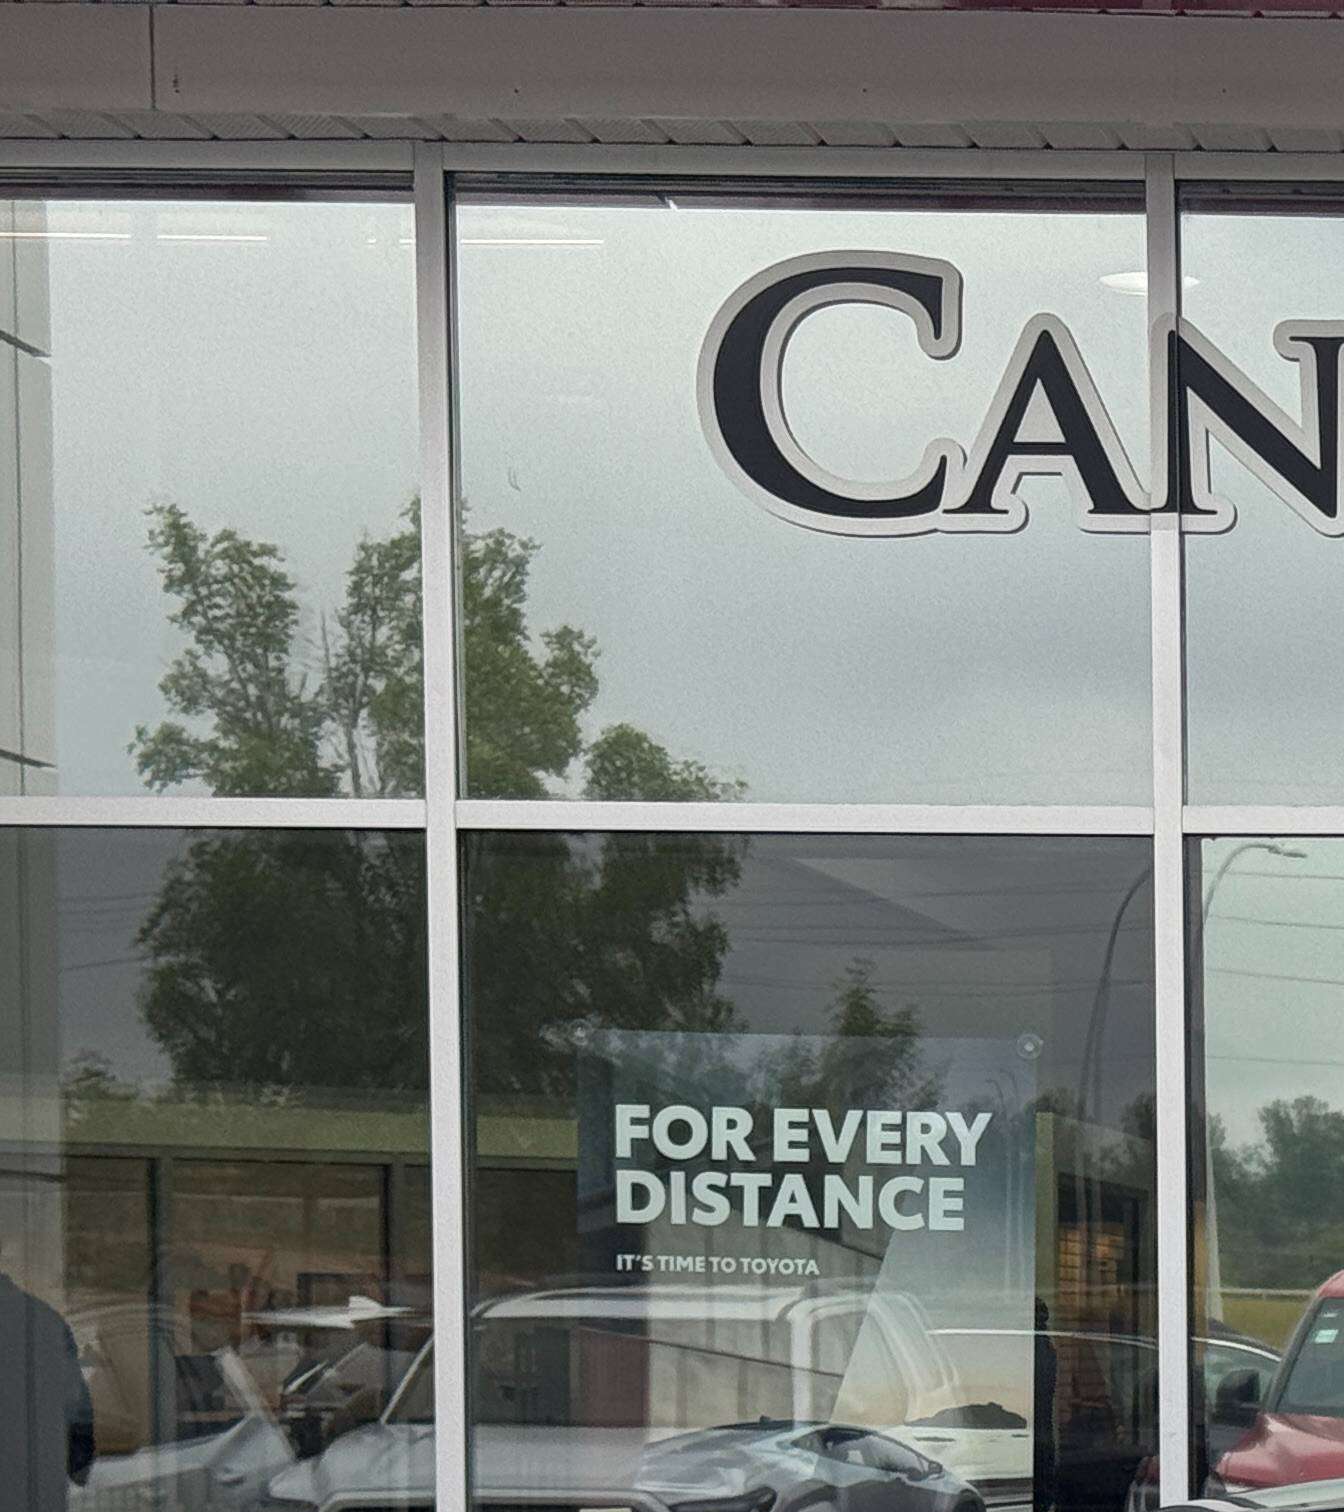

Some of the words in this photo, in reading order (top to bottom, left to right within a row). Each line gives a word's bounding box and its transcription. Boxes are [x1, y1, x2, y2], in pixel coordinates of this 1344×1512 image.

[614, 1104, 757, 1161] FOR
[772, 1107, 994, 1167] EVERY
[615, 1169, 966, 1231] DISTANCE
[616, 1254, 653, 1272] IT'S
[656, 1255, 705, 1273] TIME
[709, 1256, 736, 1274] TO
[739, 1257, 821, 1276] TOYOTA
